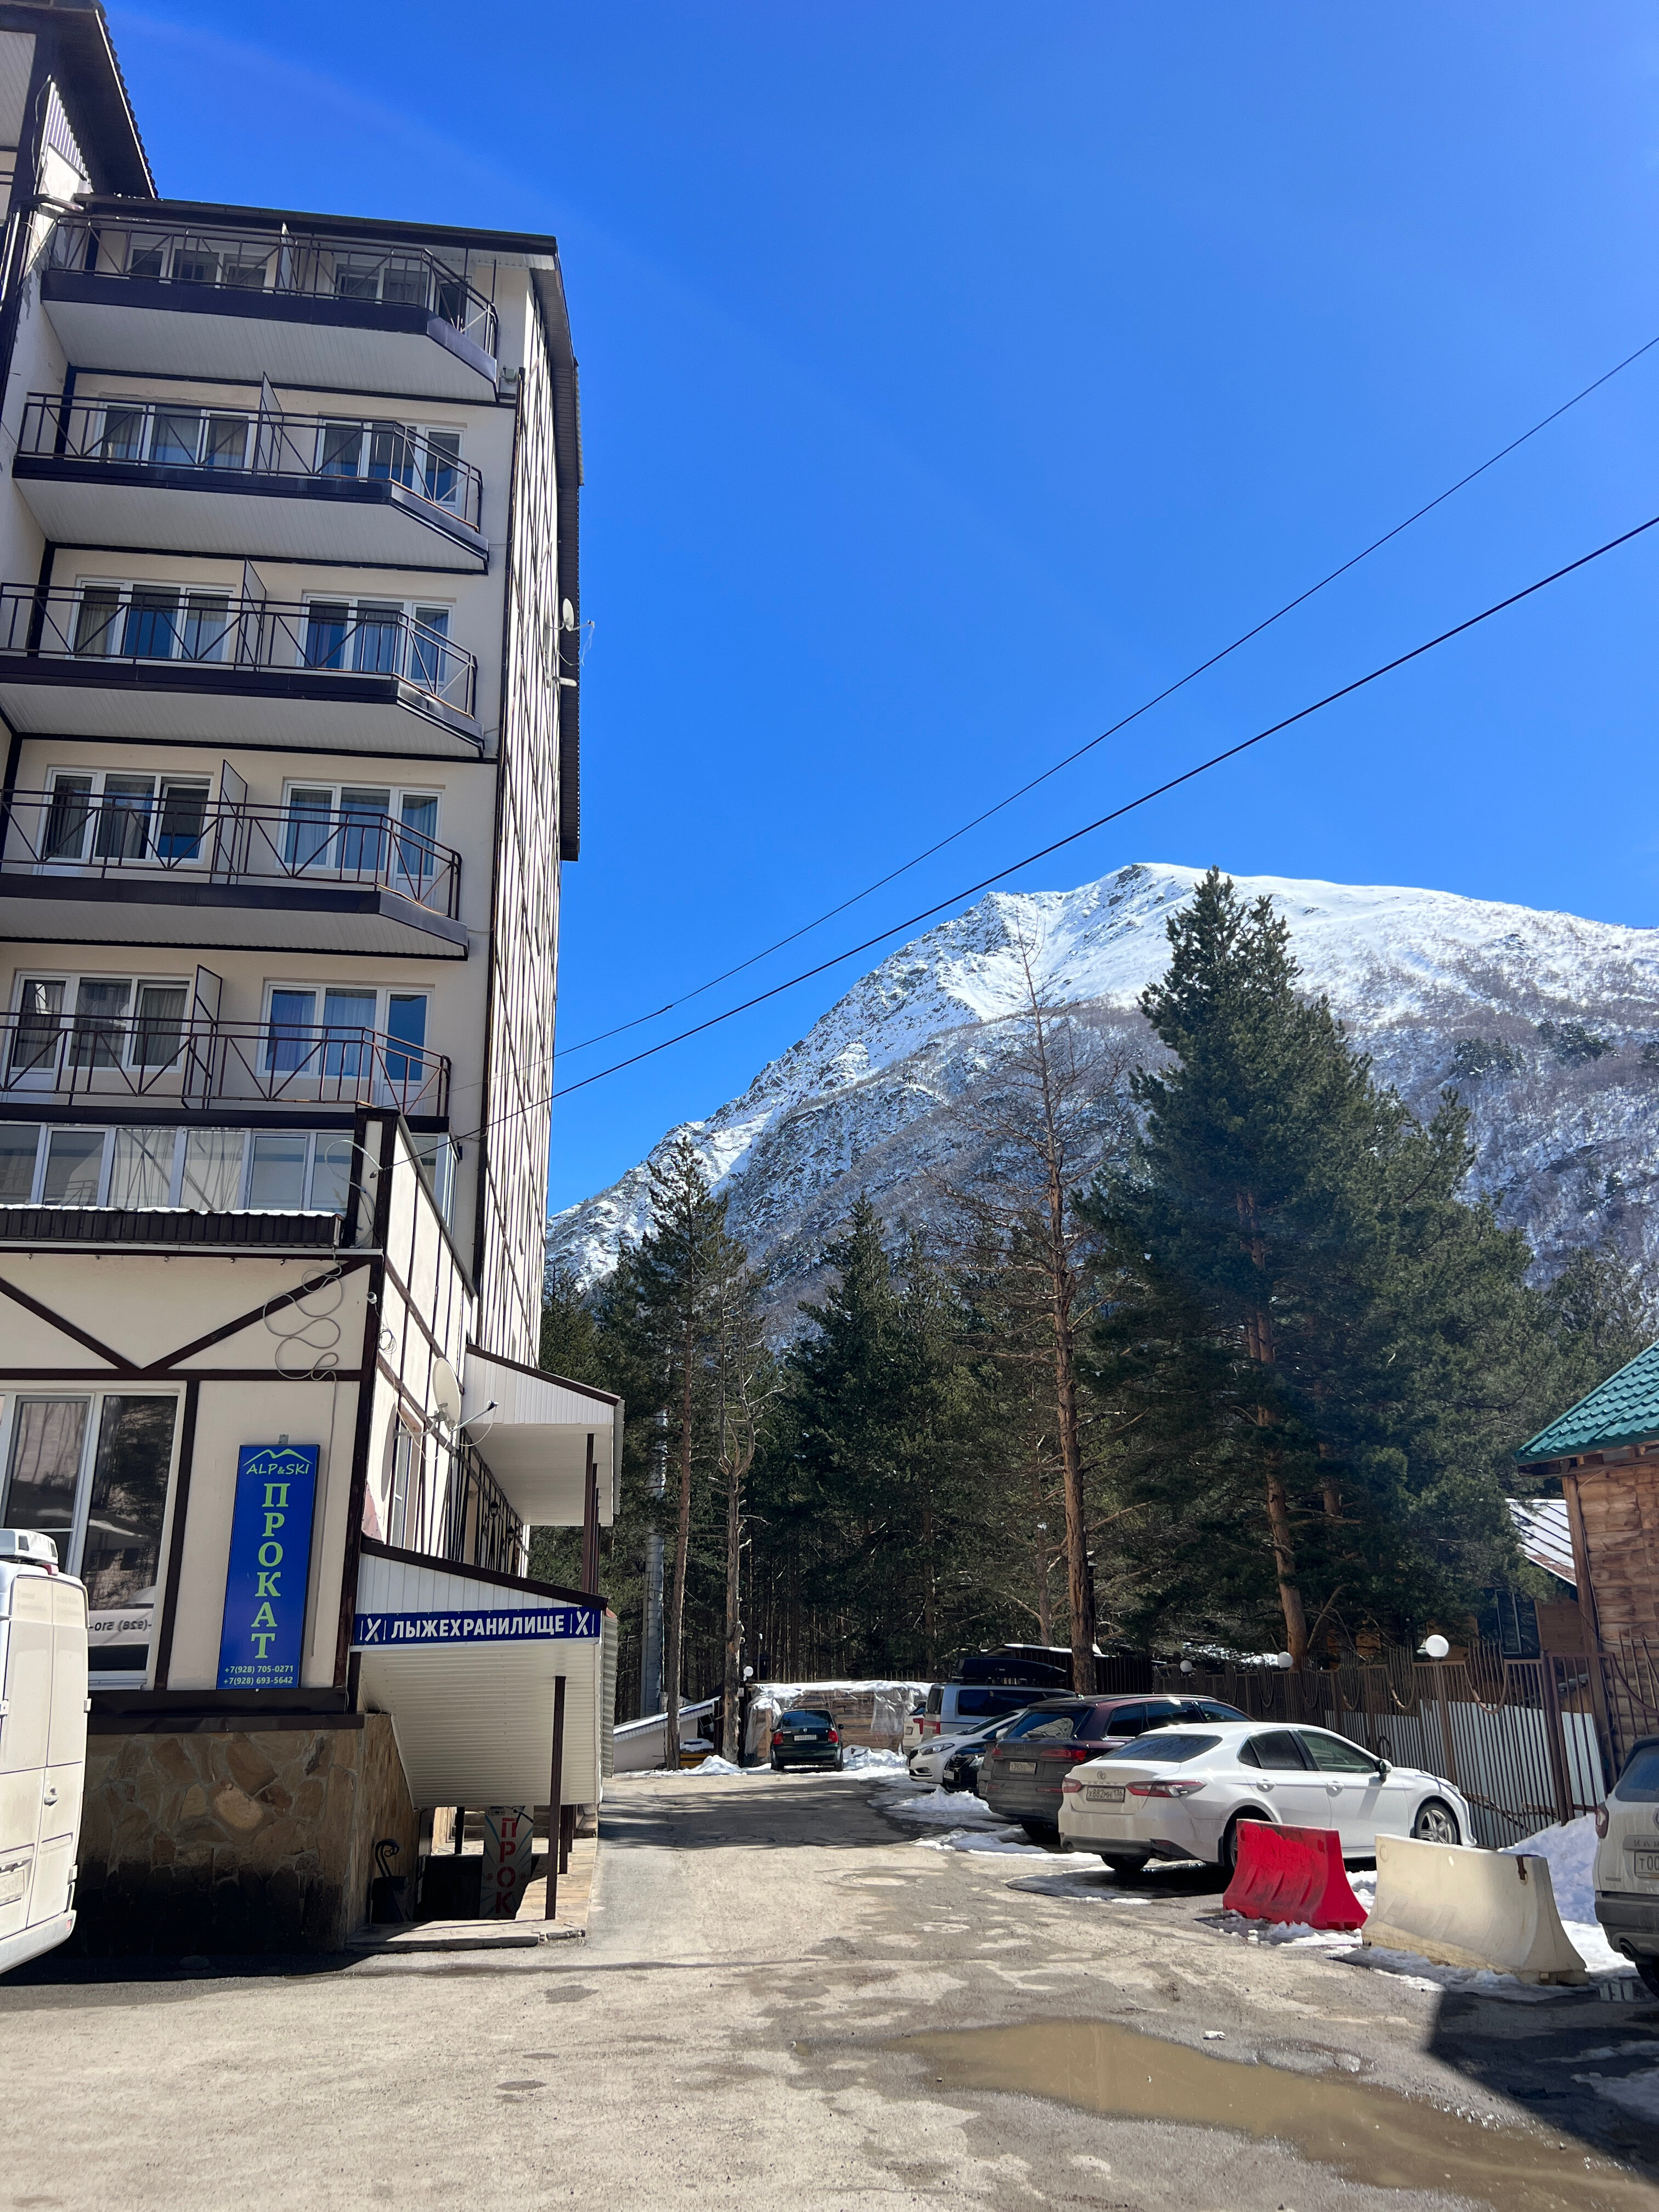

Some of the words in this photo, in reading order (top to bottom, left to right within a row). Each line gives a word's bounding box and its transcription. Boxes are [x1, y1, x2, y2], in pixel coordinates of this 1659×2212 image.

[246, 1463, 309, 1475] ALP&SKI
[251, 1483, 291, 1658] ПРОКАТ
[391, 1615, 565, 1639] ЛЫЖЕХРАНИЛИЩЕ
[224, 1666, 255, 1674] +7(928)
[257, 1664, 294, 1673] 705-0271
[223, 1677, 254, 1685] +7(928)
[256, 1676, 293, 1684] 693-5642
